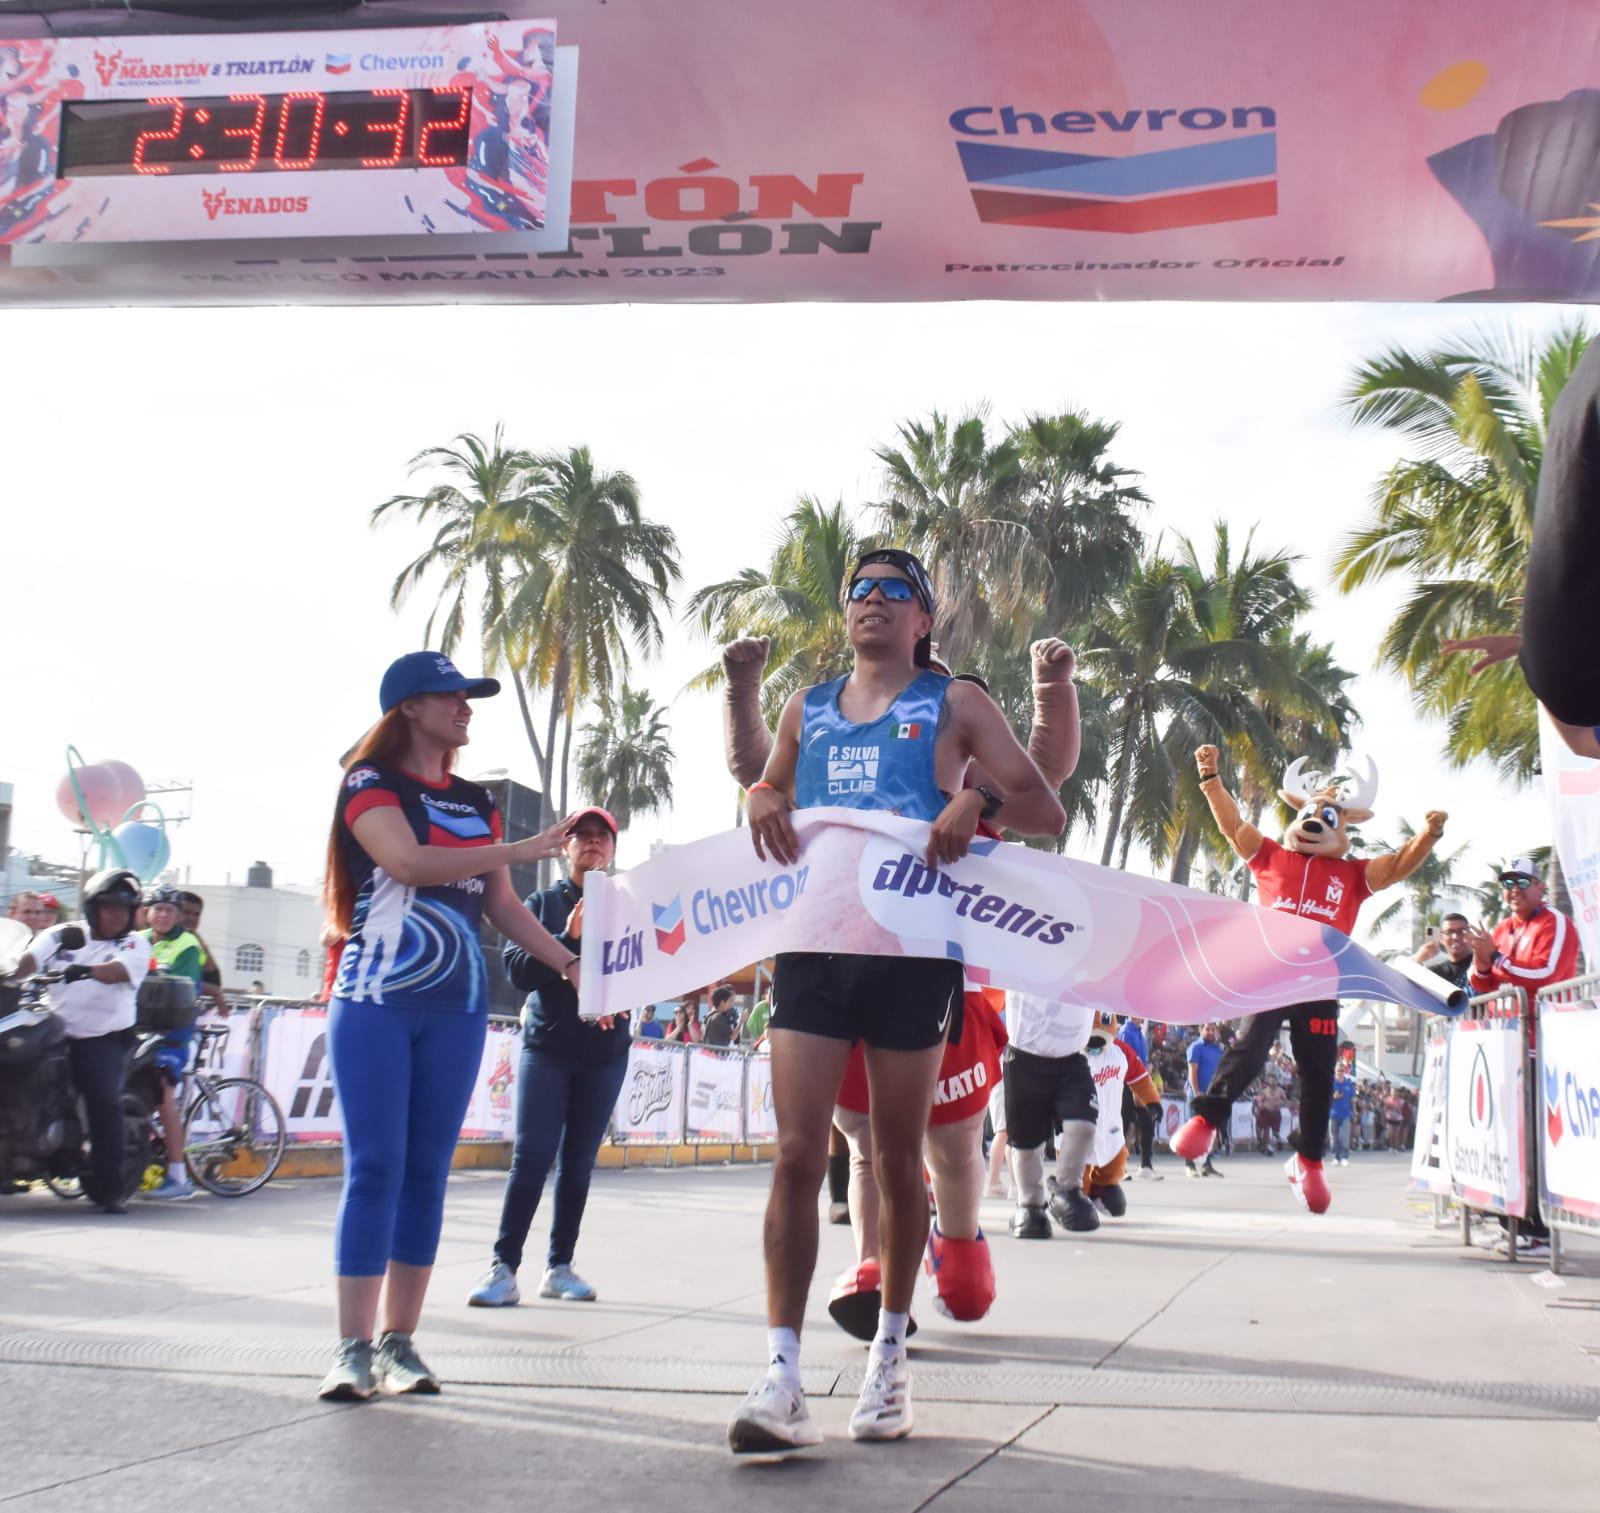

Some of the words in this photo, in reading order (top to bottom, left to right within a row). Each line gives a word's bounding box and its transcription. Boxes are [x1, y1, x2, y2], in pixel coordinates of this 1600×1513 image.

[119, 59, 209, 80] MARATÓN
[226, 56, 315, 76] TRIATLÓN
[359, 53, 444, 71] Chevron
[948, 105, 1277, 136] Chevron
[944, 261, 1200, 273] Patrocinador
[1213, 256, 1345, 269] Oficial
[377, 267, 610, 281] MAZATLÁN
[621, 267, 726, 278] 2023
[841, 745, 880, 761] SILVA
[828, 780, 876, 795] CLUB
[692, 864, 810, 935] Chevron
[1309, 1017, 1337, 1036] 911
